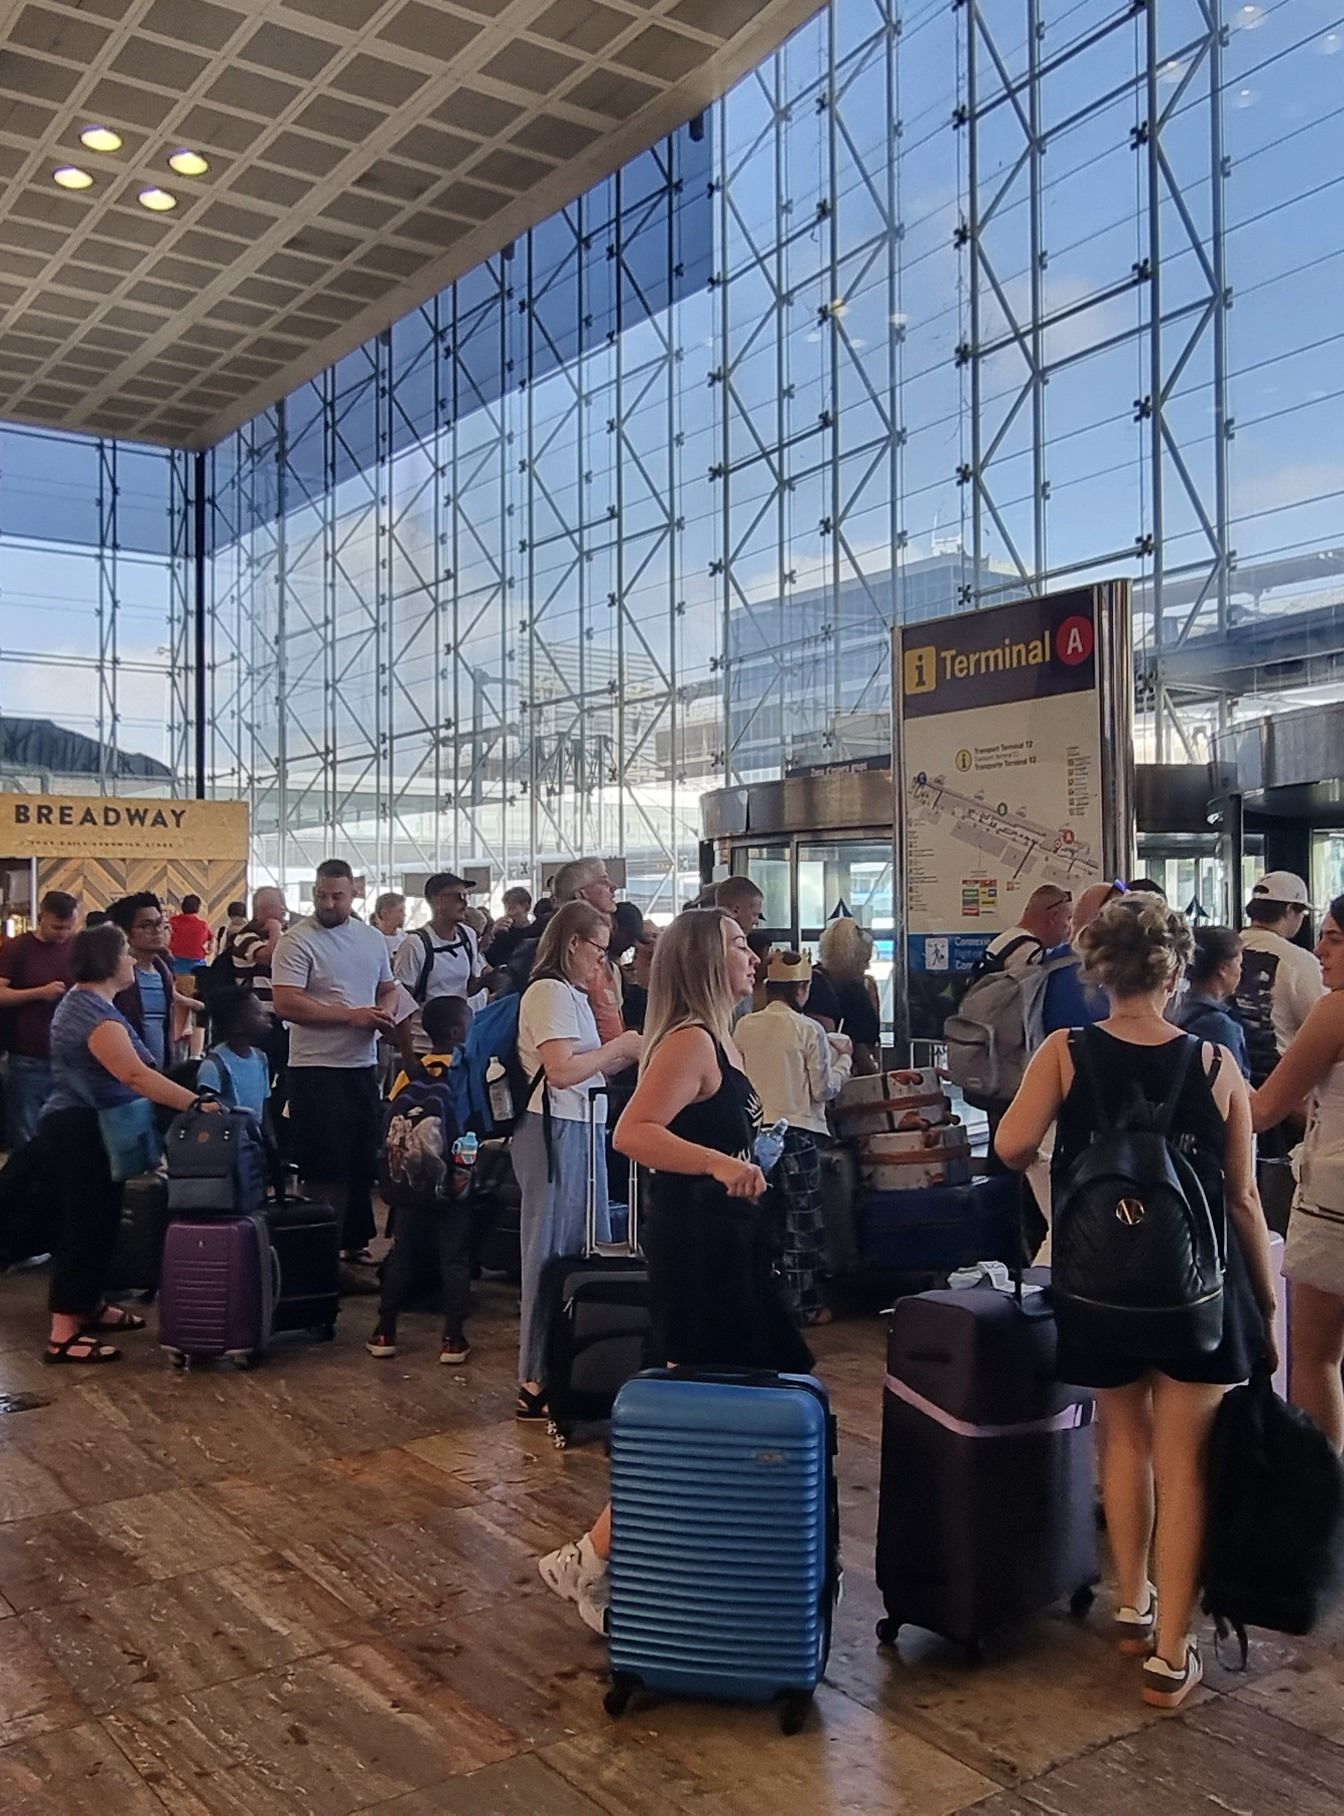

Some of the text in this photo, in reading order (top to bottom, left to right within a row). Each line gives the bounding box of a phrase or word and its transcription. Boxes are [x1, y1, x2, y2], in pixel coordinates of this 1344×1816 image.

[940, 630, 1051, 681] Terminal
[1066, 627, 1084, 655] A
[15, 804, 186, 829] BREADWAY
